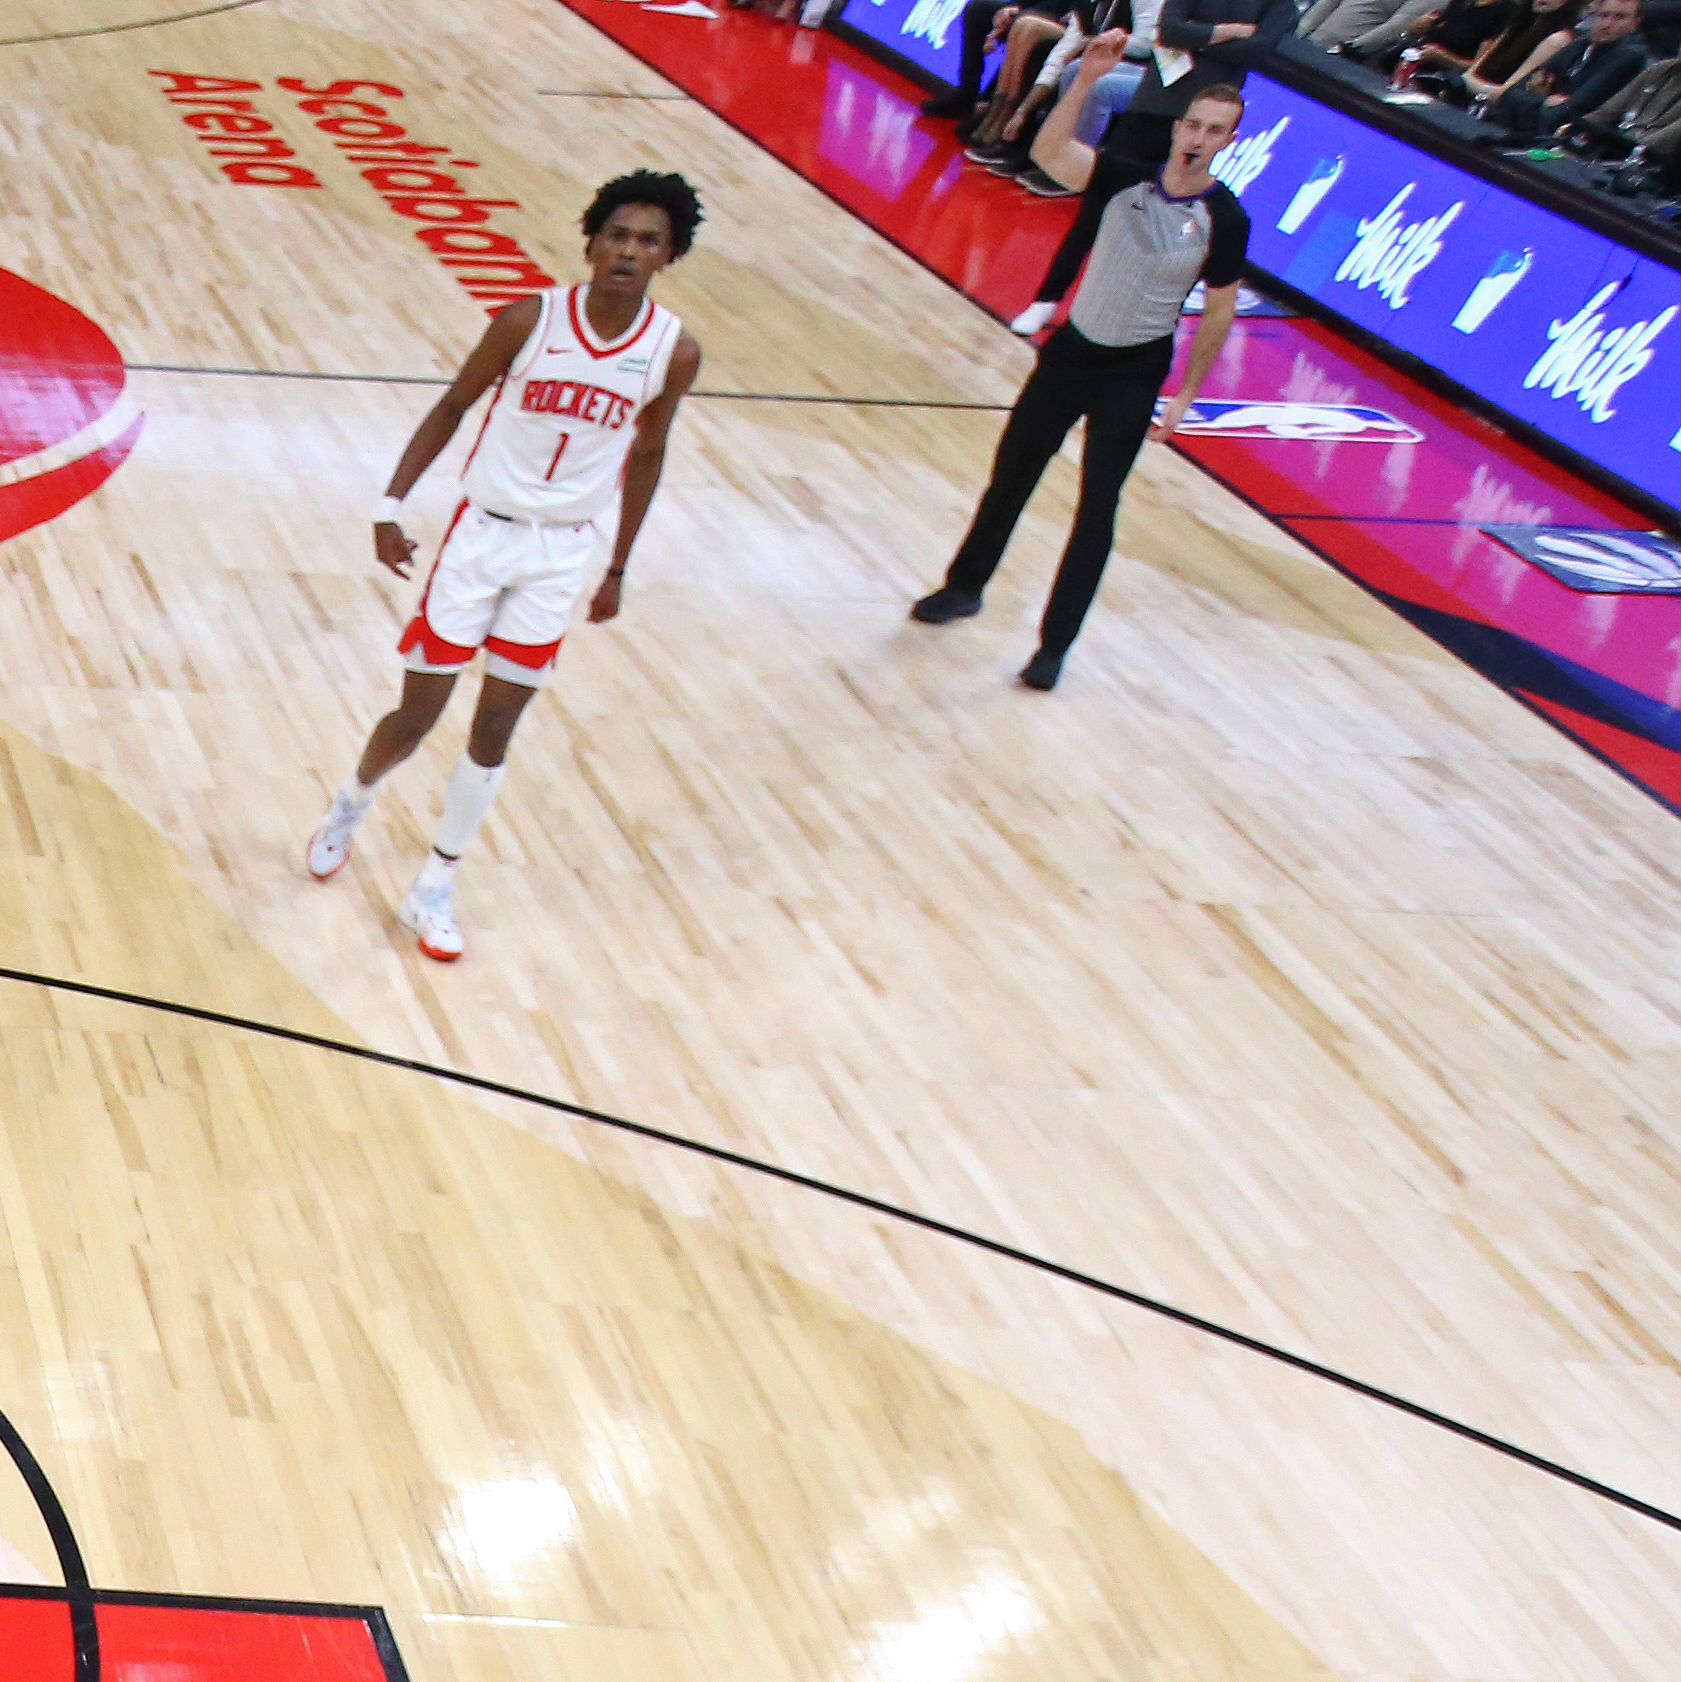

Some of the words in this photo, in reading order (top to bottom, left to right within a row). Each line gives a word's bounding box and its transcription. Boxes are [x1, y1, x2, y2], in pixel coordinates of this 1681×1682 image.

[147, 69, 323, 189] Arena
[1208, 117, 1290, 197] ilk
[1335, 183, 1464, 309] Milk
[1523, 281, 1680, 423] Milk
[521, 380, 634, 429] ROCKETS
[545, 432, 569, 481] 1
